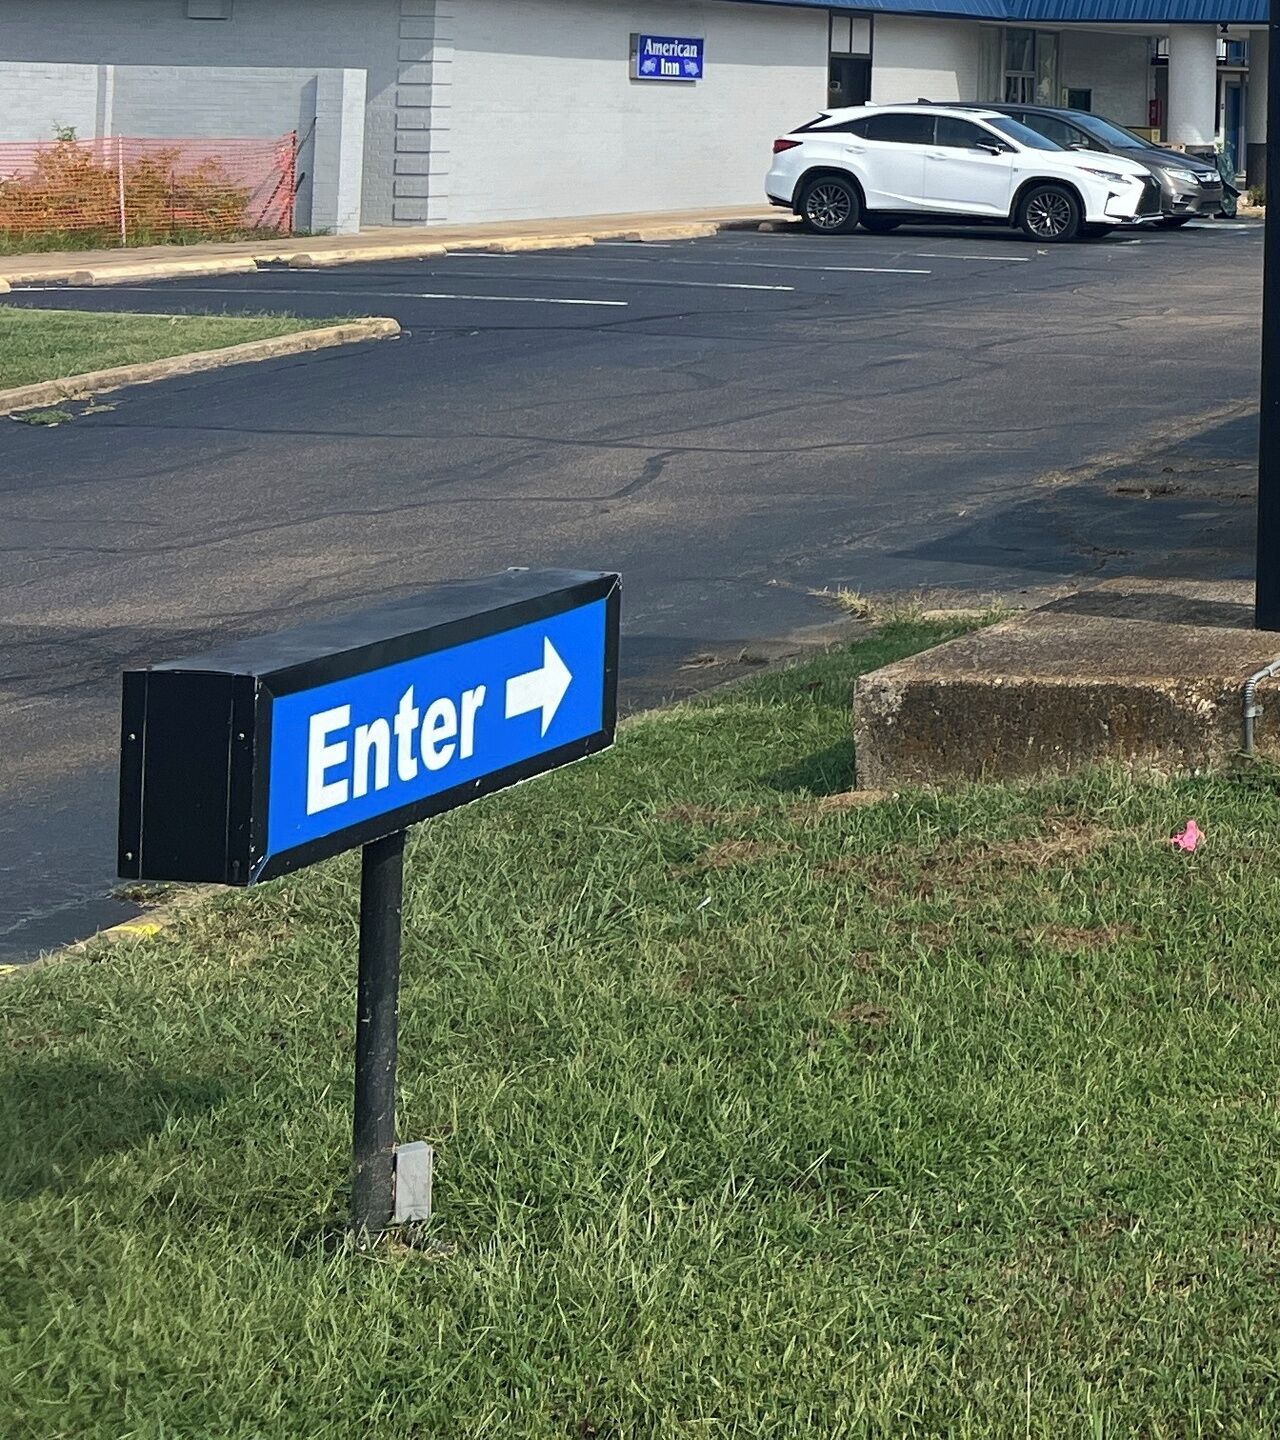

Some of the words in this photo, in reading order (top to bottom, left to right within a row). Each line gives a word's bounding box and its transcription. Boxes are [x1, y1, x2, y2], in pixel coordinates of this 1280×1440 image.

[644, 38, 698, 57] American
[660, 58, 680, 75] Inn
[306, 684, 487, 817] Enter
